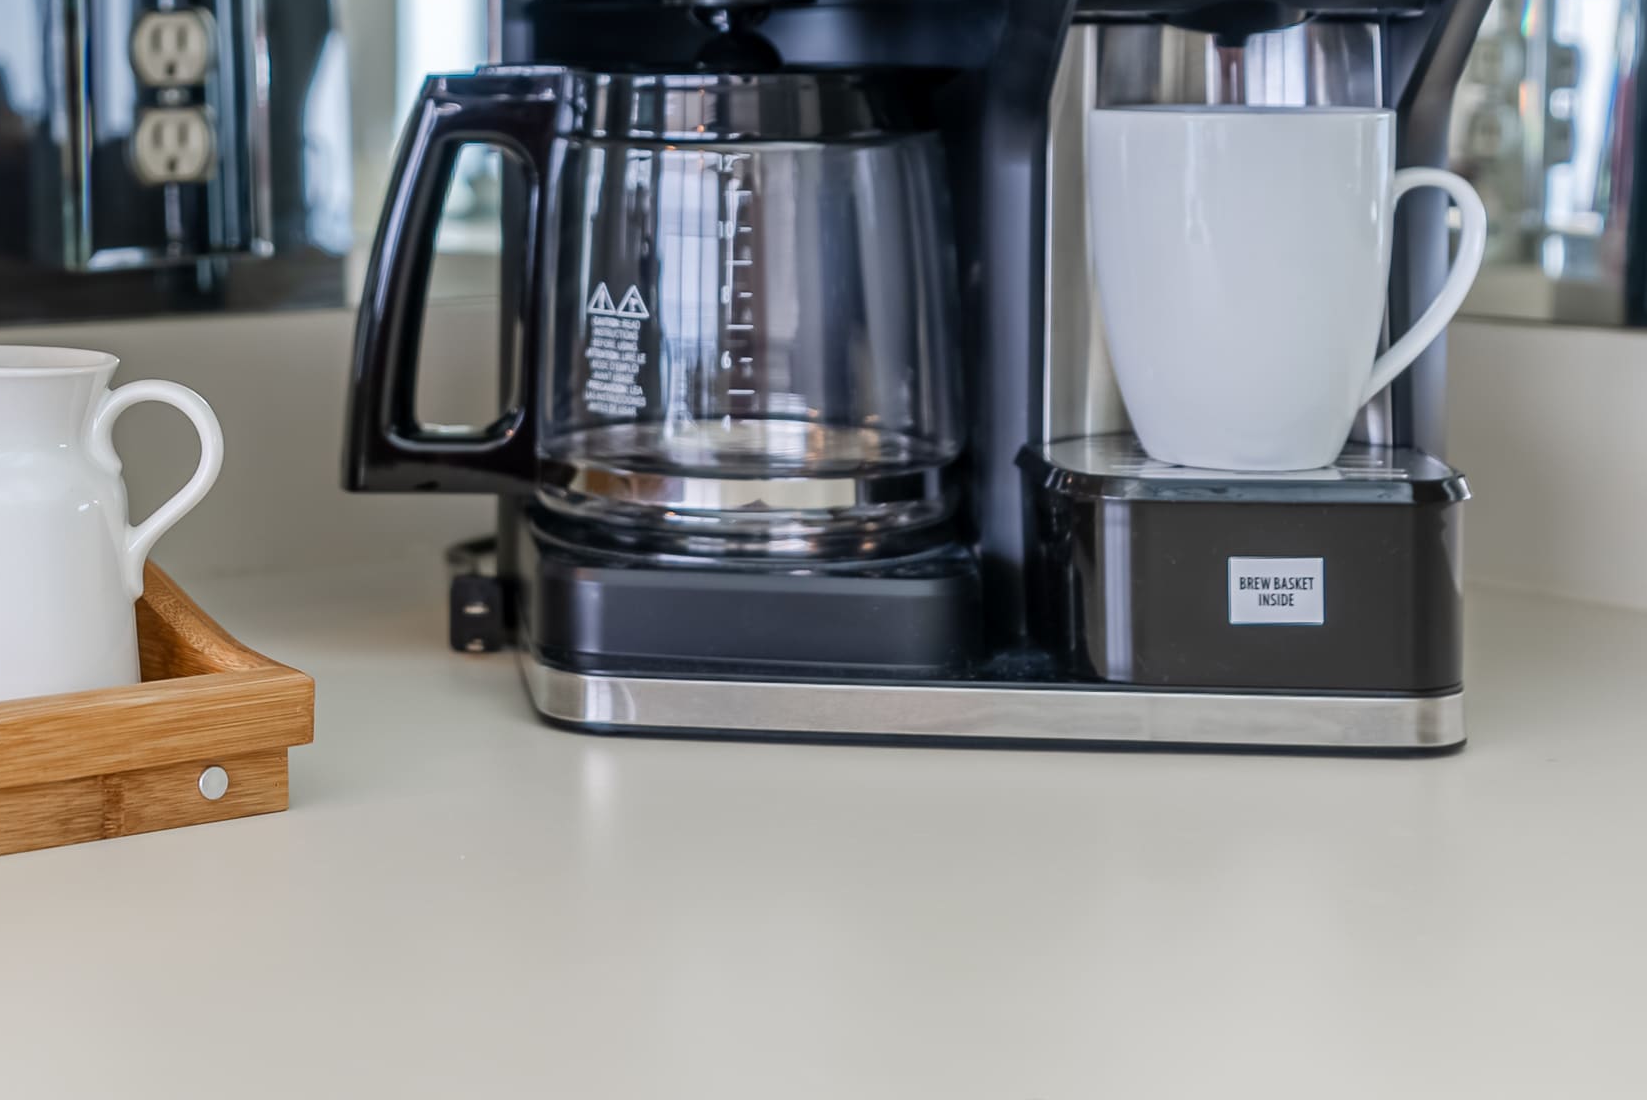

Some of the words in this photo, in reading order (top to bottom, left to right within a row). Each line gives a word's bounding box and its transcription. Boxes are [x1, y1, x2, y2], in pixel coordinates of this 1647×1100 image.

[720, 285, 731, 304] 8
[720, 350, 732, 369] 6
[1239, 576, 1272, 590] BREW
[1273, 576, 1314, 590] BASKET
[1258, 593, 1295, 606] INSIDE
